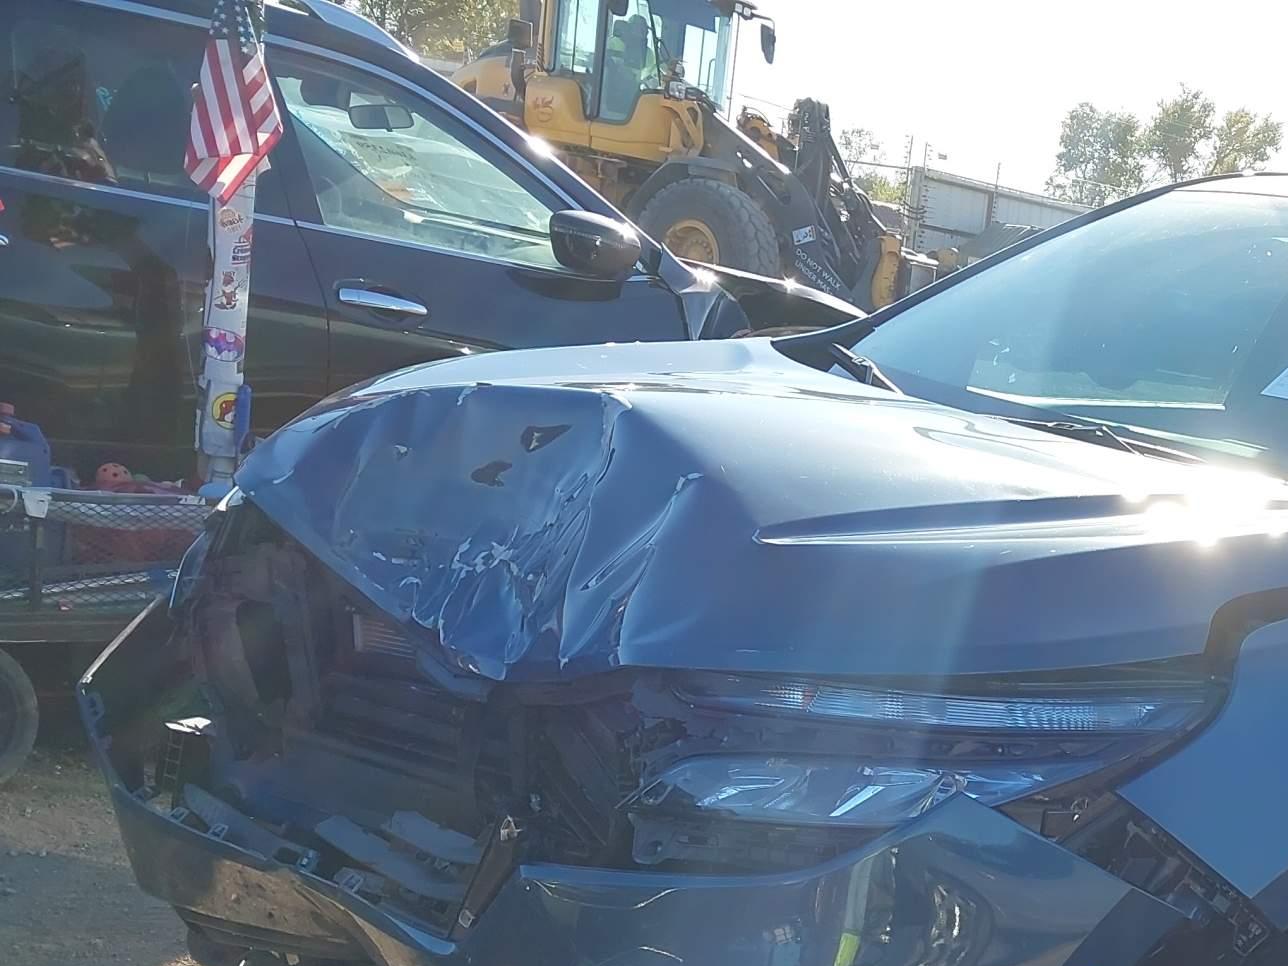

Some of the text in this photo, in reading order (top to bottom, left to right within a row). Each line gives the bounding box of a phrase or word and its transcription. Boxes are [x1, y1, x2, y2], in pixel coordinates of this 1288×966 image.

[795, 260, 817, 281] UNDER
[806, 258, 822, 272] NOT
[822, 271, 841, 290] WALK
